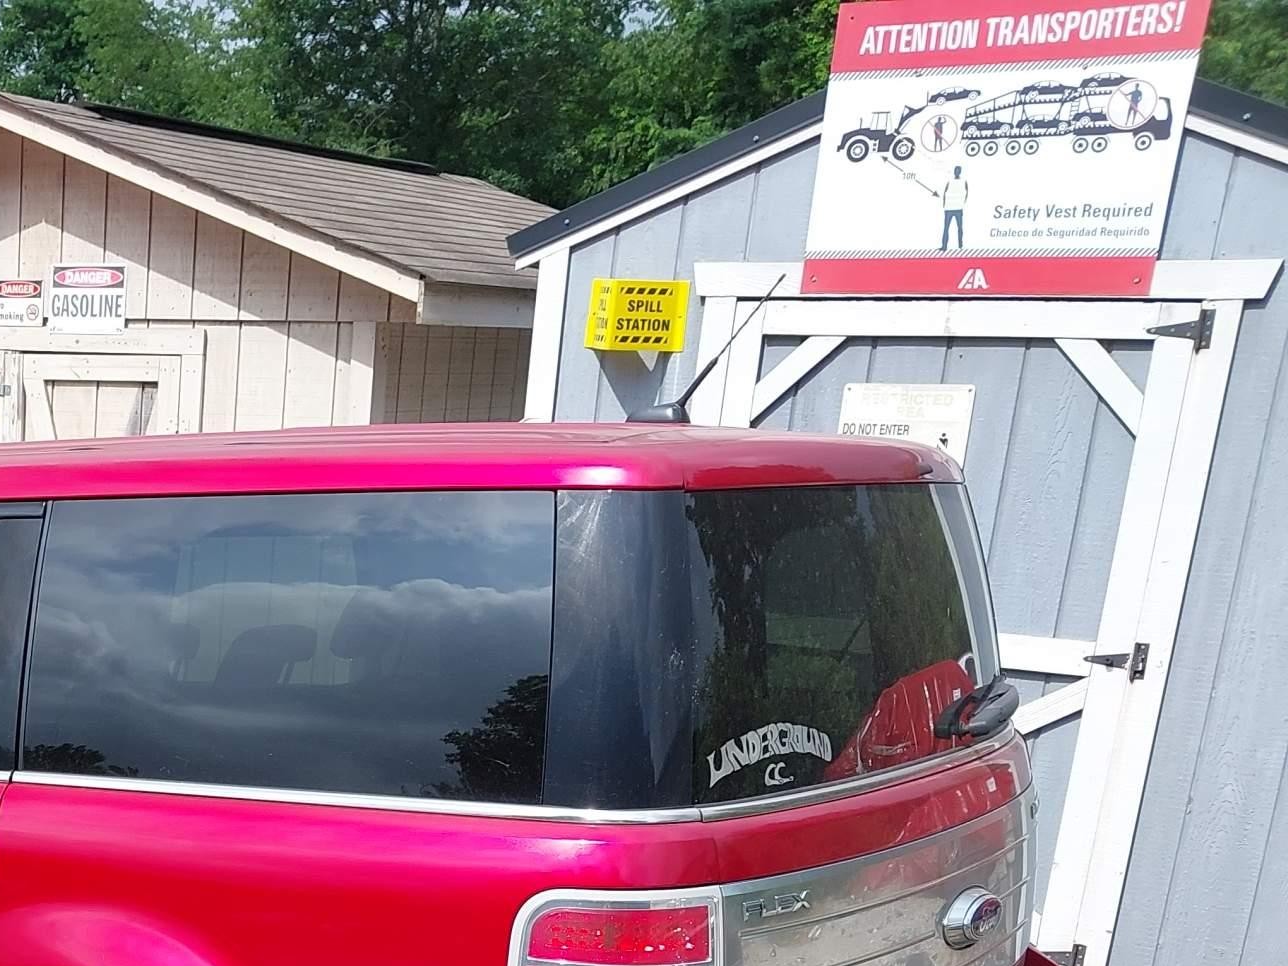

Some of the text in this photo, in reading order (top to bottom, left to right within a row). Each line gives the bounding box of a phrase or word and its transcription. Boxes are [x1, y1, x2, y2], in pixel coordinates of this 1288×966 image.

[859, 1, 1187, 55] ATTENTION TRANSPORTERS!
[993, 202, 1154, 221] Safety Vest Required
[990, 226, 1150, 239] Chaleco de Seguridad Requirido
[63, 272, 111, 284] DANGER
[0, 284, 34, 294] DANGER
[52, 294, 123, 317] GASOLINE
[627, 300, 663, 312] SPILL
[616, 318, 670, 331] STATION
[843, 423, 909, 435] DO NOT ENTER
[706, 722, 832, 788] UNDERGROUND
[742, 890, 810, 921] FLEX
